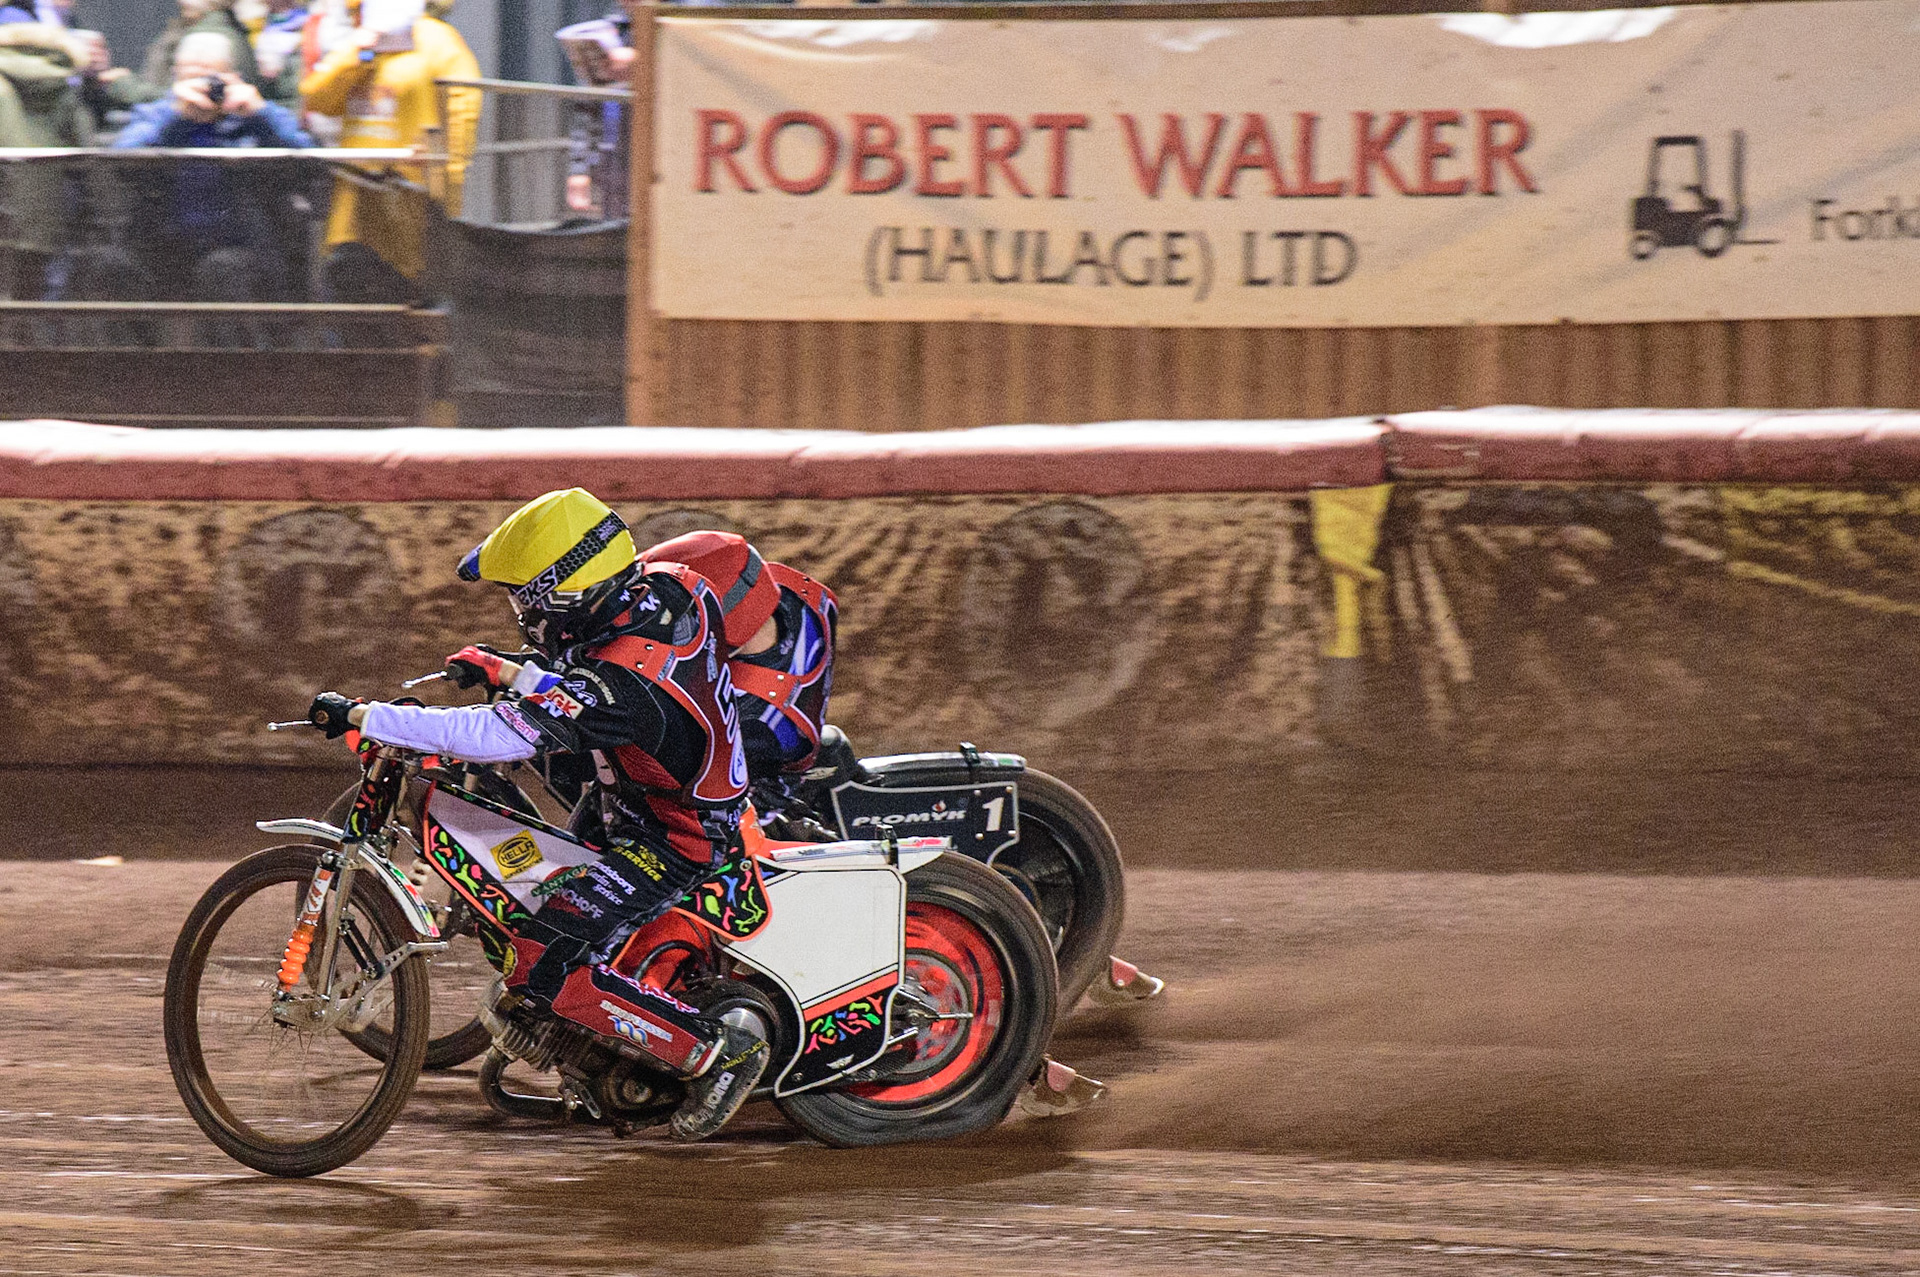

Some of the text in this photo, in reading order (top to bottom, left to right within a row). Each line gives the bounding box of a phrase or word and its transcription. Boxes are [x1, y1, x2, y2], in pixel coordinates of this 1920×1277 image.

[693, 109, 1539, 198] ROBERT WALKER
[1811, 195, 1920, 241] Fork
[865, 226, 1358, 301] (HAULAGE) LTD
[982, 797, 1005, 832] 1
[500, 839, 535, 862] HELLA
[620, 845, 663, 882] SERVICE
